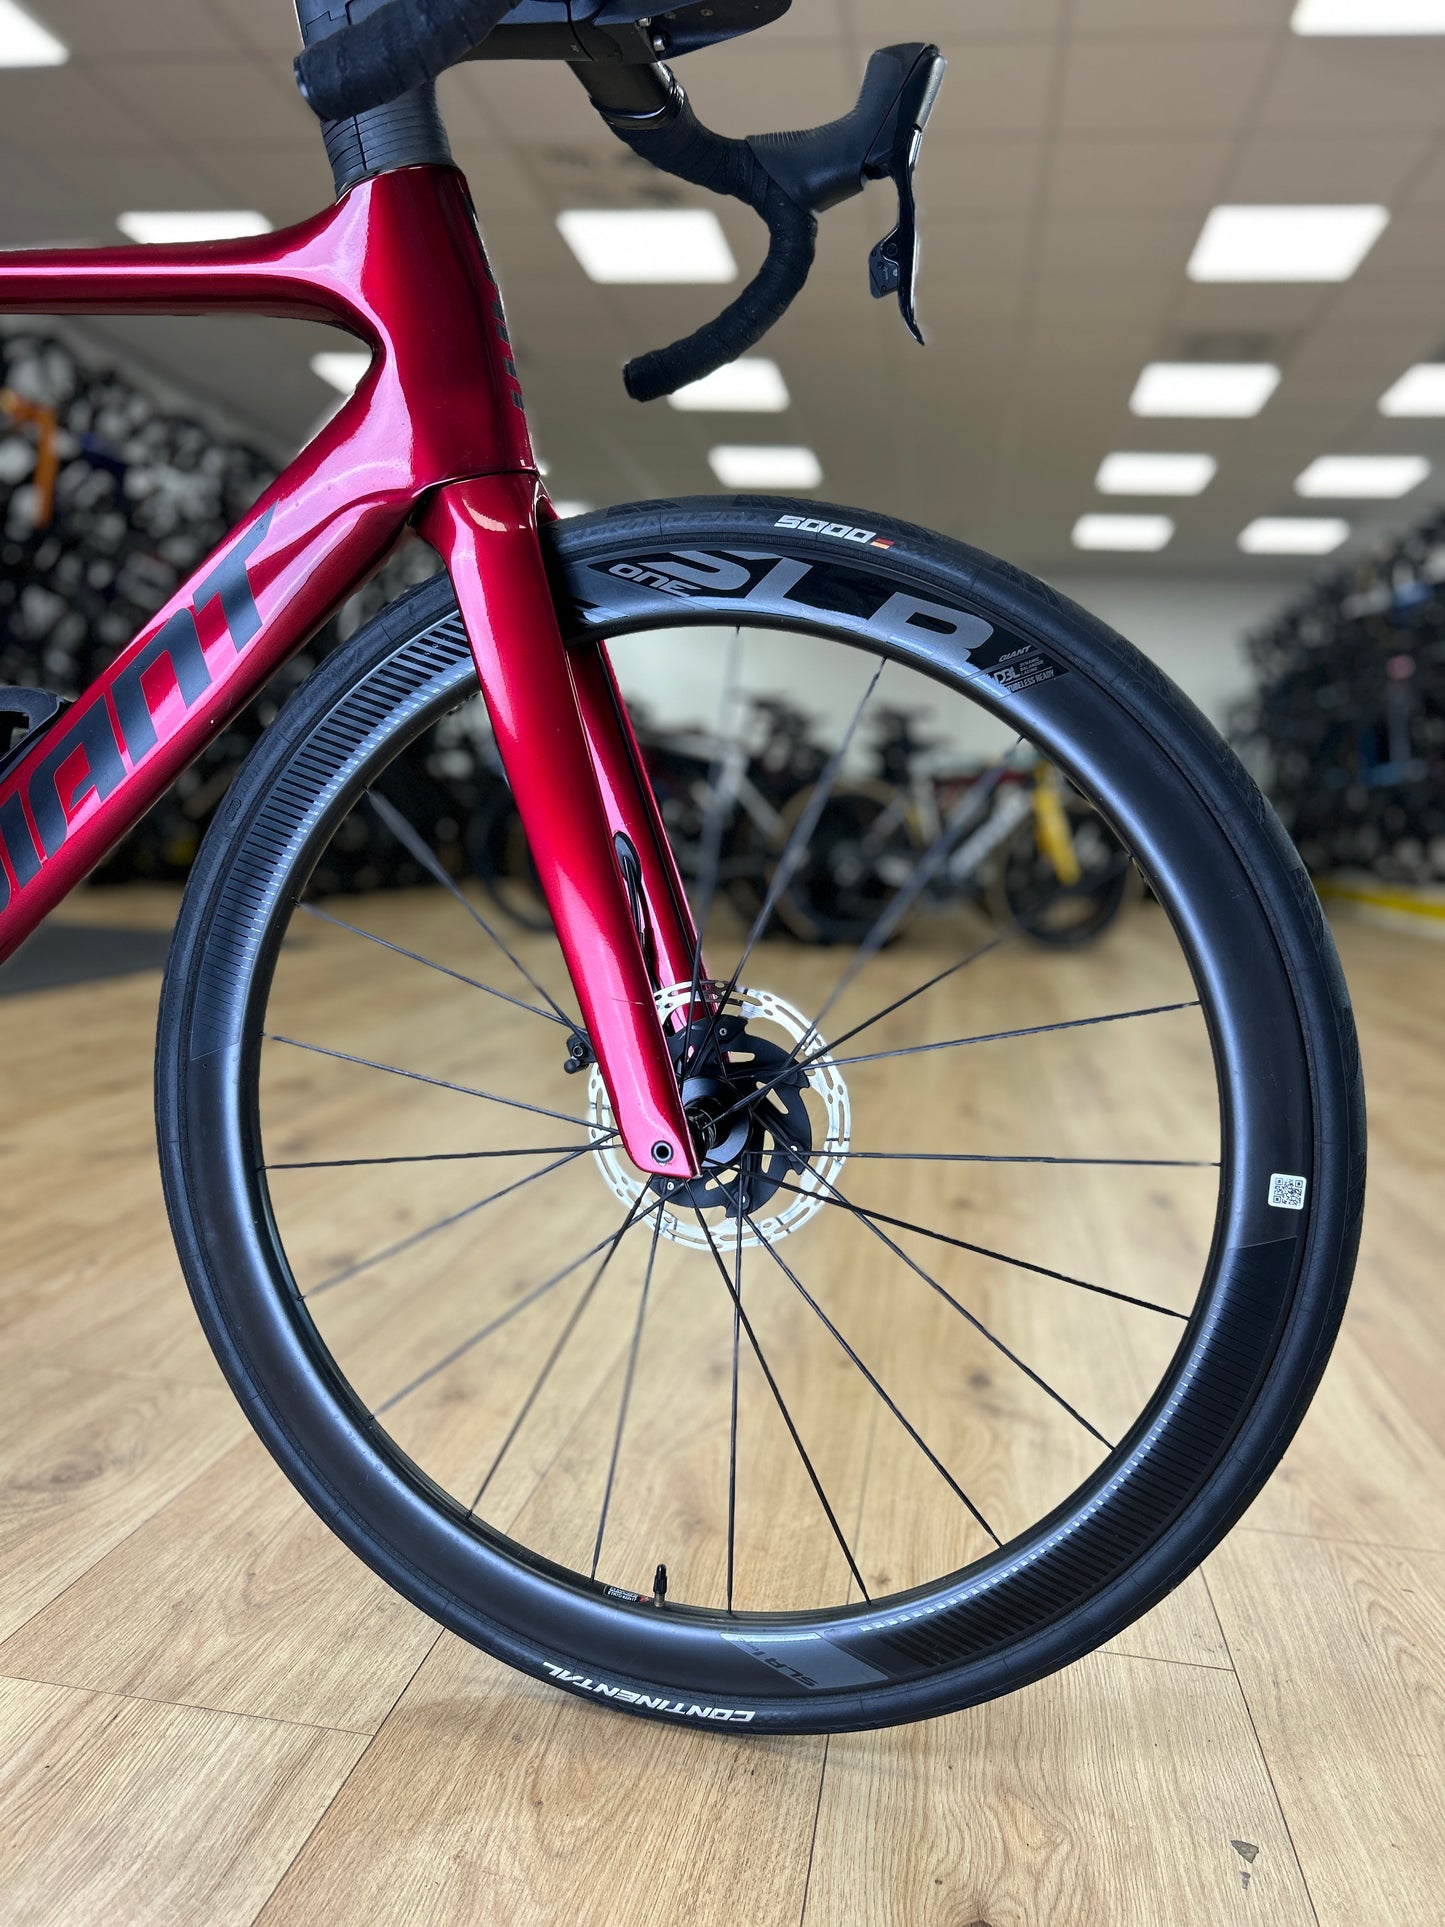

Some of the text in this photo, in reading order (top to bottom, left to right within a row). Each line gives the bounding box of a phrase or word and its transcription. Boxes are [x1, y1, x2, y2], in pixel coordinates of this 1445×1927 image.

[774, 514, 877, 544] 5000
[637, 550, 994, 668] SLR
[998, 644, 1032, 662] GIANT
[1007, 669, 1055, 692] TUBELESS READY
[0, 500, 279, 912] IANT
[543, 1661, 756, 1722] CONTINENTAL
